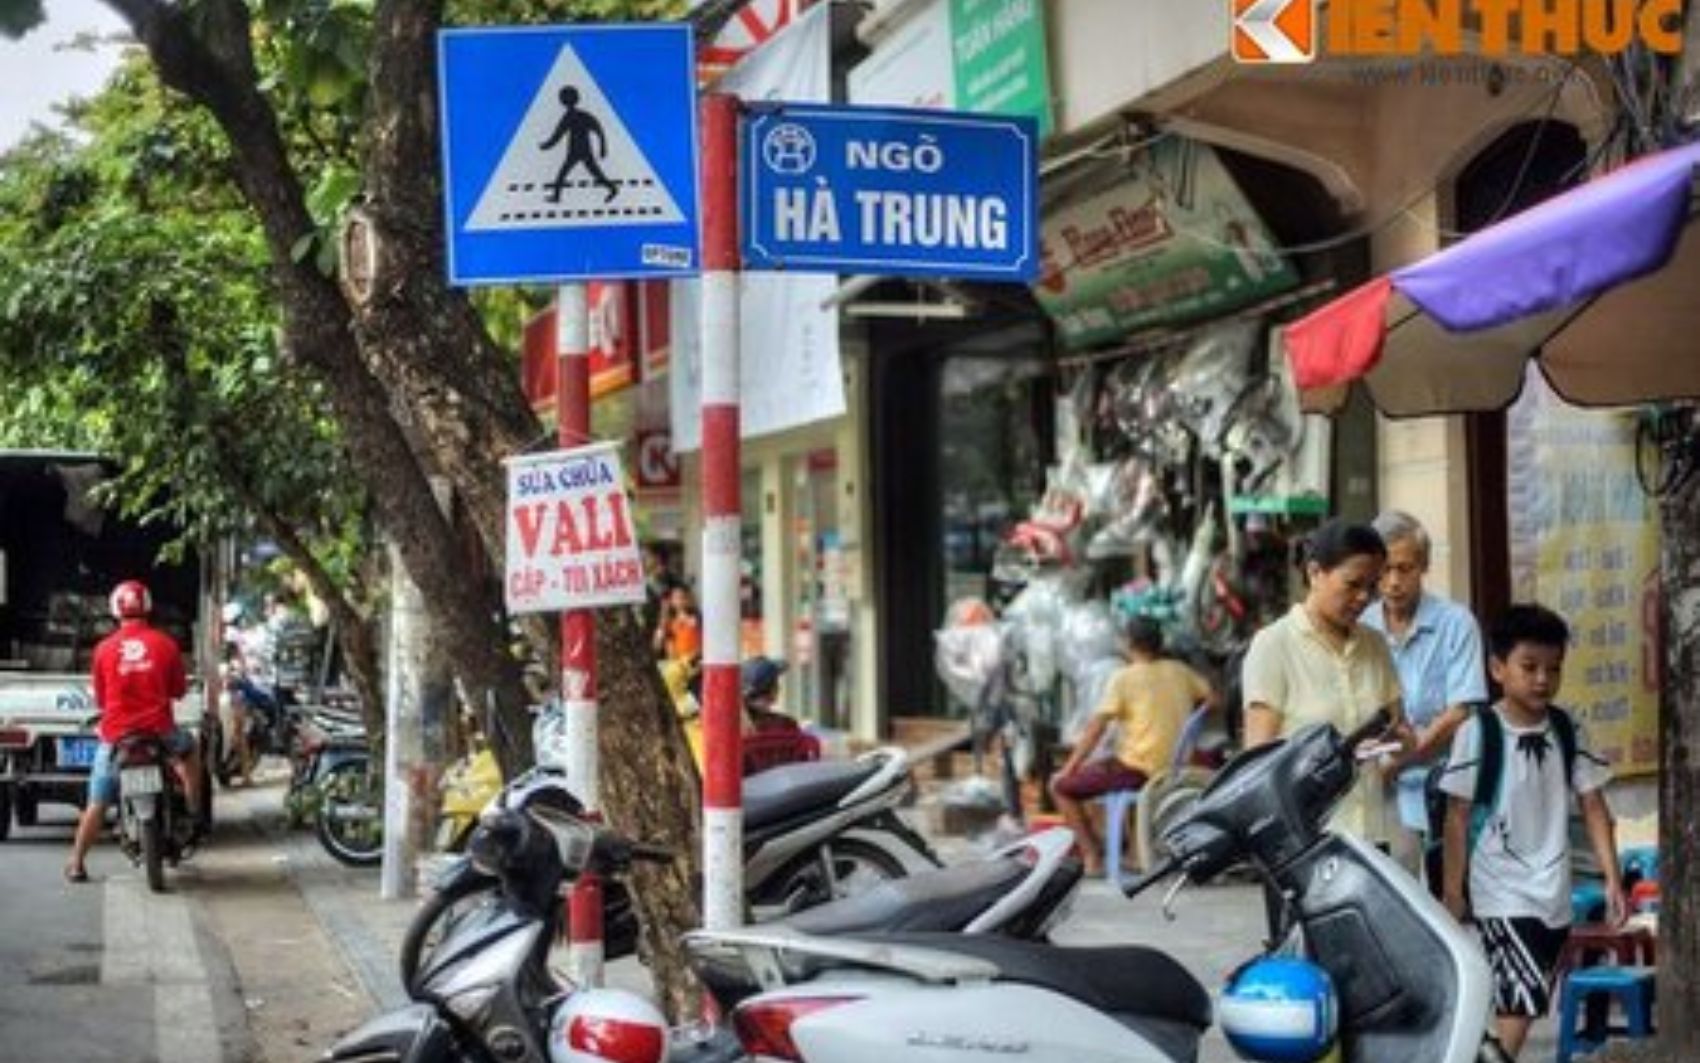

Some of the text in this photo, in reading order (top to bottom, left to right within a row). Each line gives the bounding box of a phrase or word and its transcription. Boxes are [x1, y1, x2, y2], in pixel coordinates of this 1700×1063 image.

[846, 133, 943, 173] NGÕ
[773, 175, 841, 242] HÀ
[855, 190, 1008, 250] TRUNG
[513, 492, 631, 559] VALI
